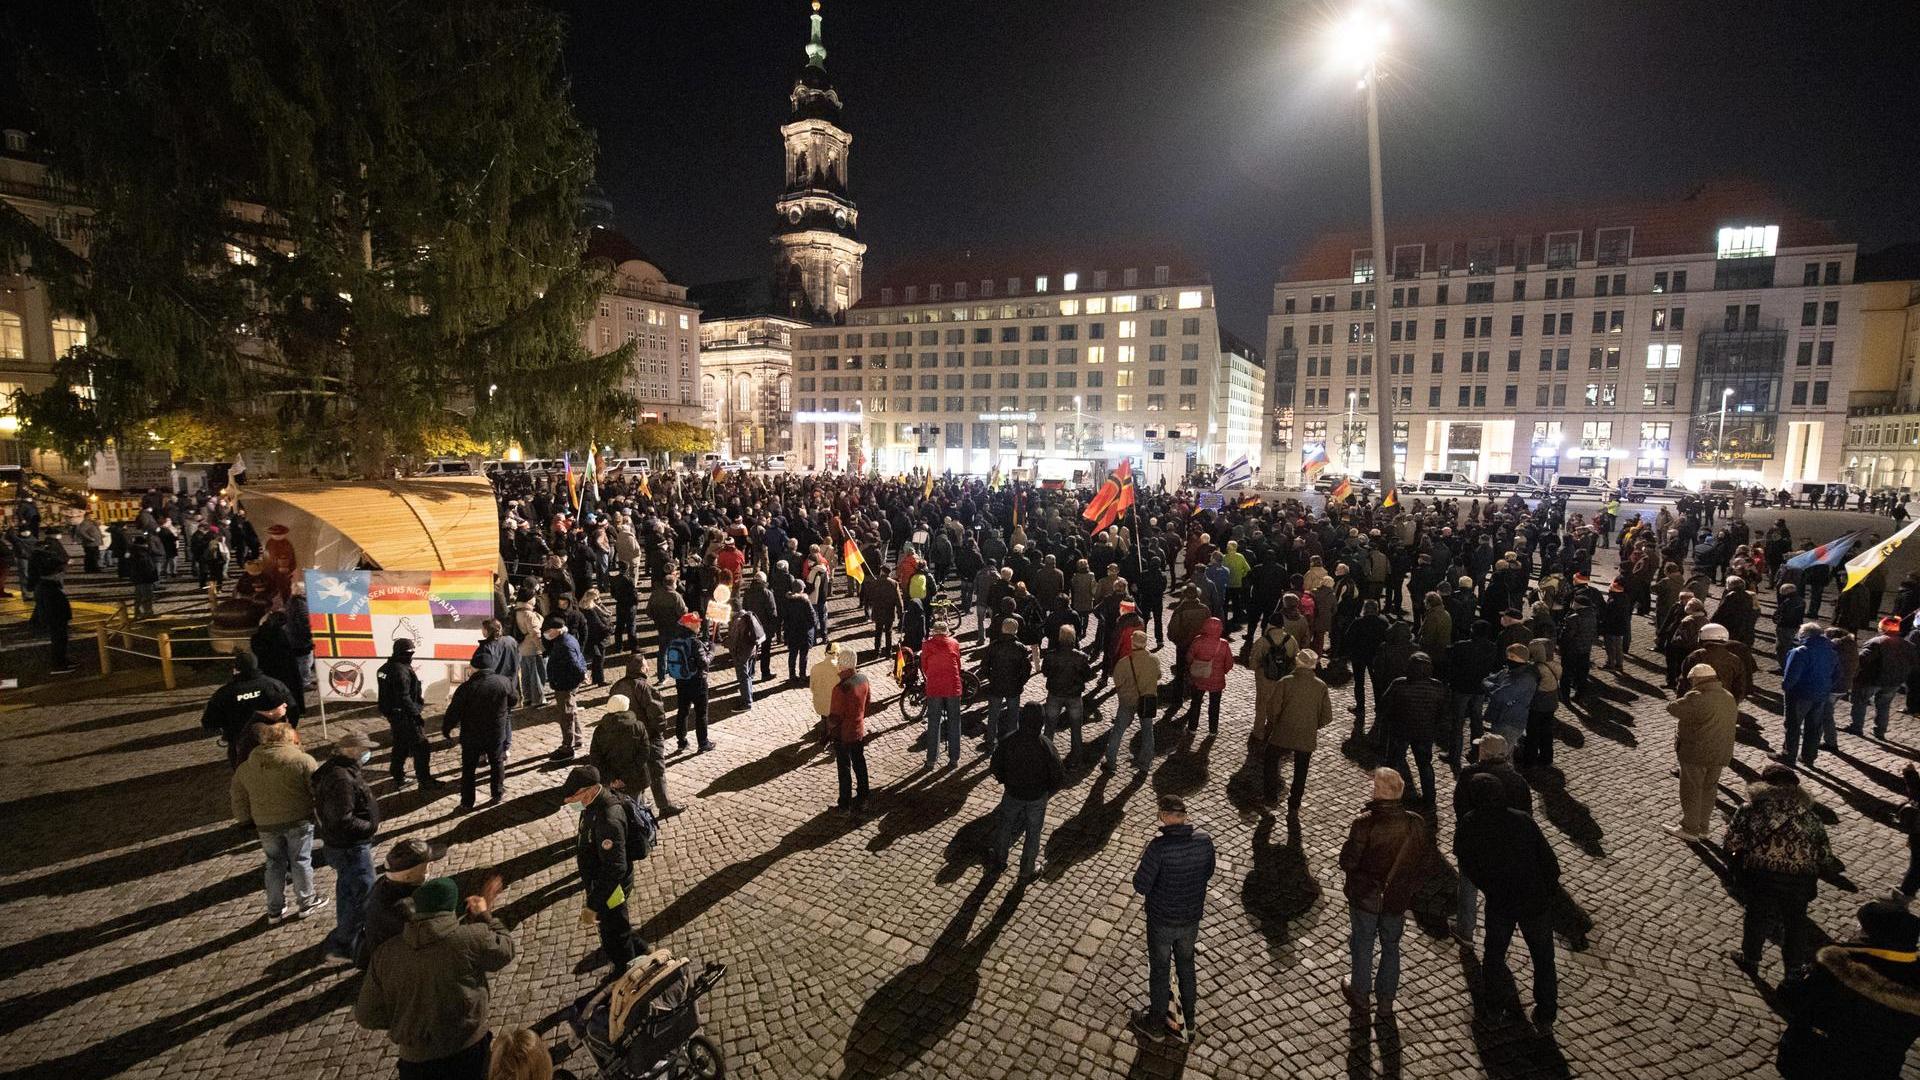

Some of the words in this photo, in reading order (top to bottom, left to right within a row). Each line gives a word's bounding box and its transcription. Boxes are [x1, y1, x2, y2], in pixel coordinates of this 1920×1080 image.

[387, 586, 405, 595] UNS
[406, 586, 429, 600] NICHT
[429, 594, 461, 623] SPALTEN
